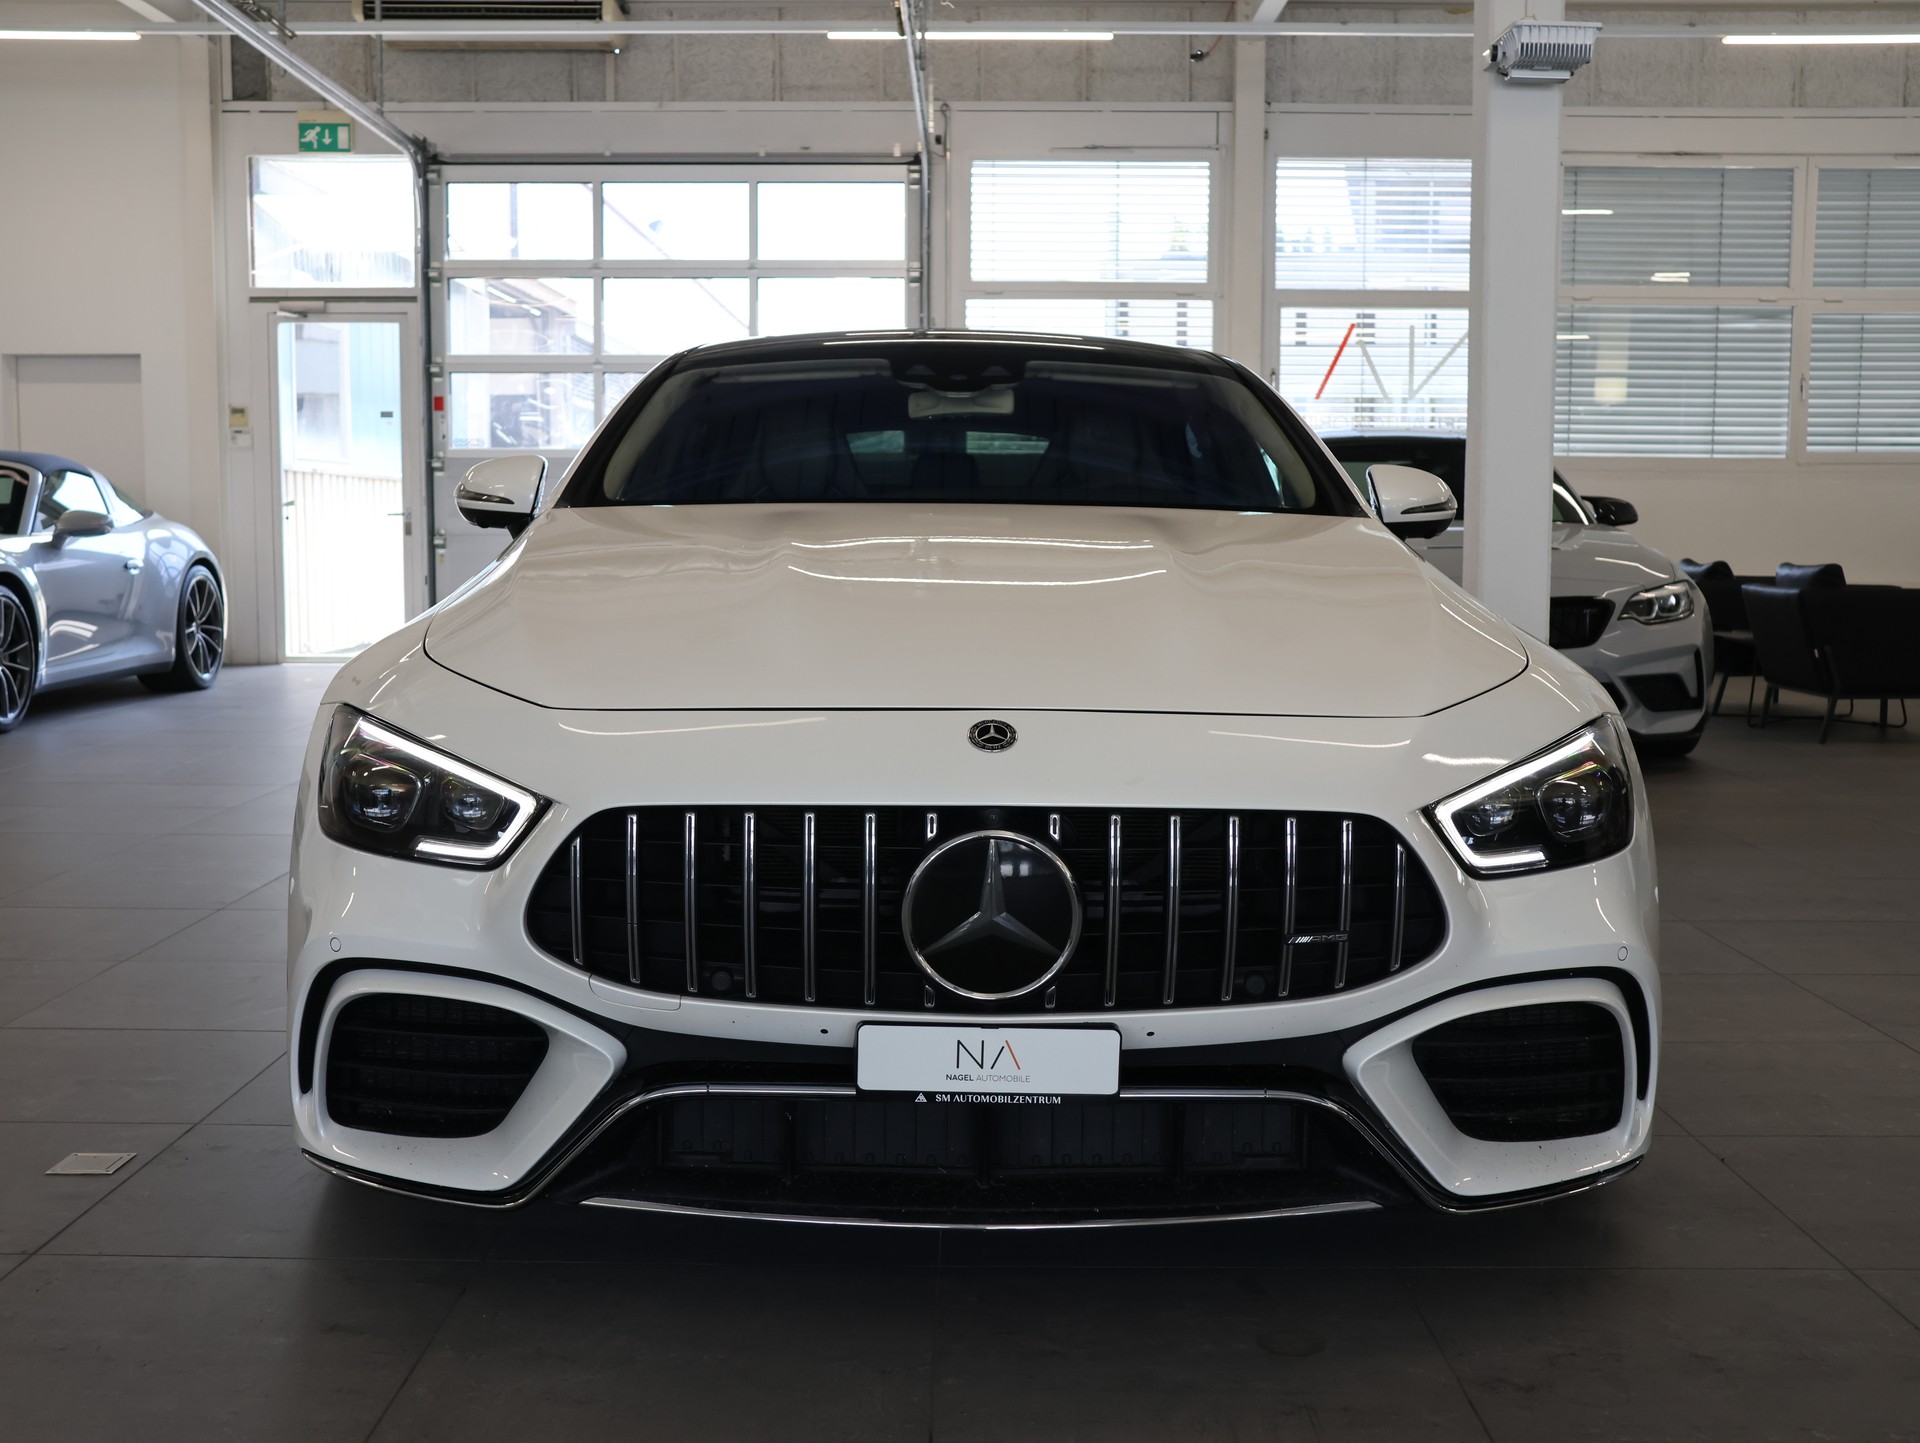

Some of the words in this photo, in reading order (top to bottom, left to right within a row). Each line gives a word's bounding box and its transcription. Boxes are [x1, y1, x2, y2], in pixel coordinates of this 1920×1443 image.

[945, 1074, 974, 1082] NAGEL
[976, 1075, 1031, 1083] AUTOMOBILE
[935, 1093, 951, 1102] SM
[953, 1094, 1061, 1104] AUTOMOBILZENTRUM
